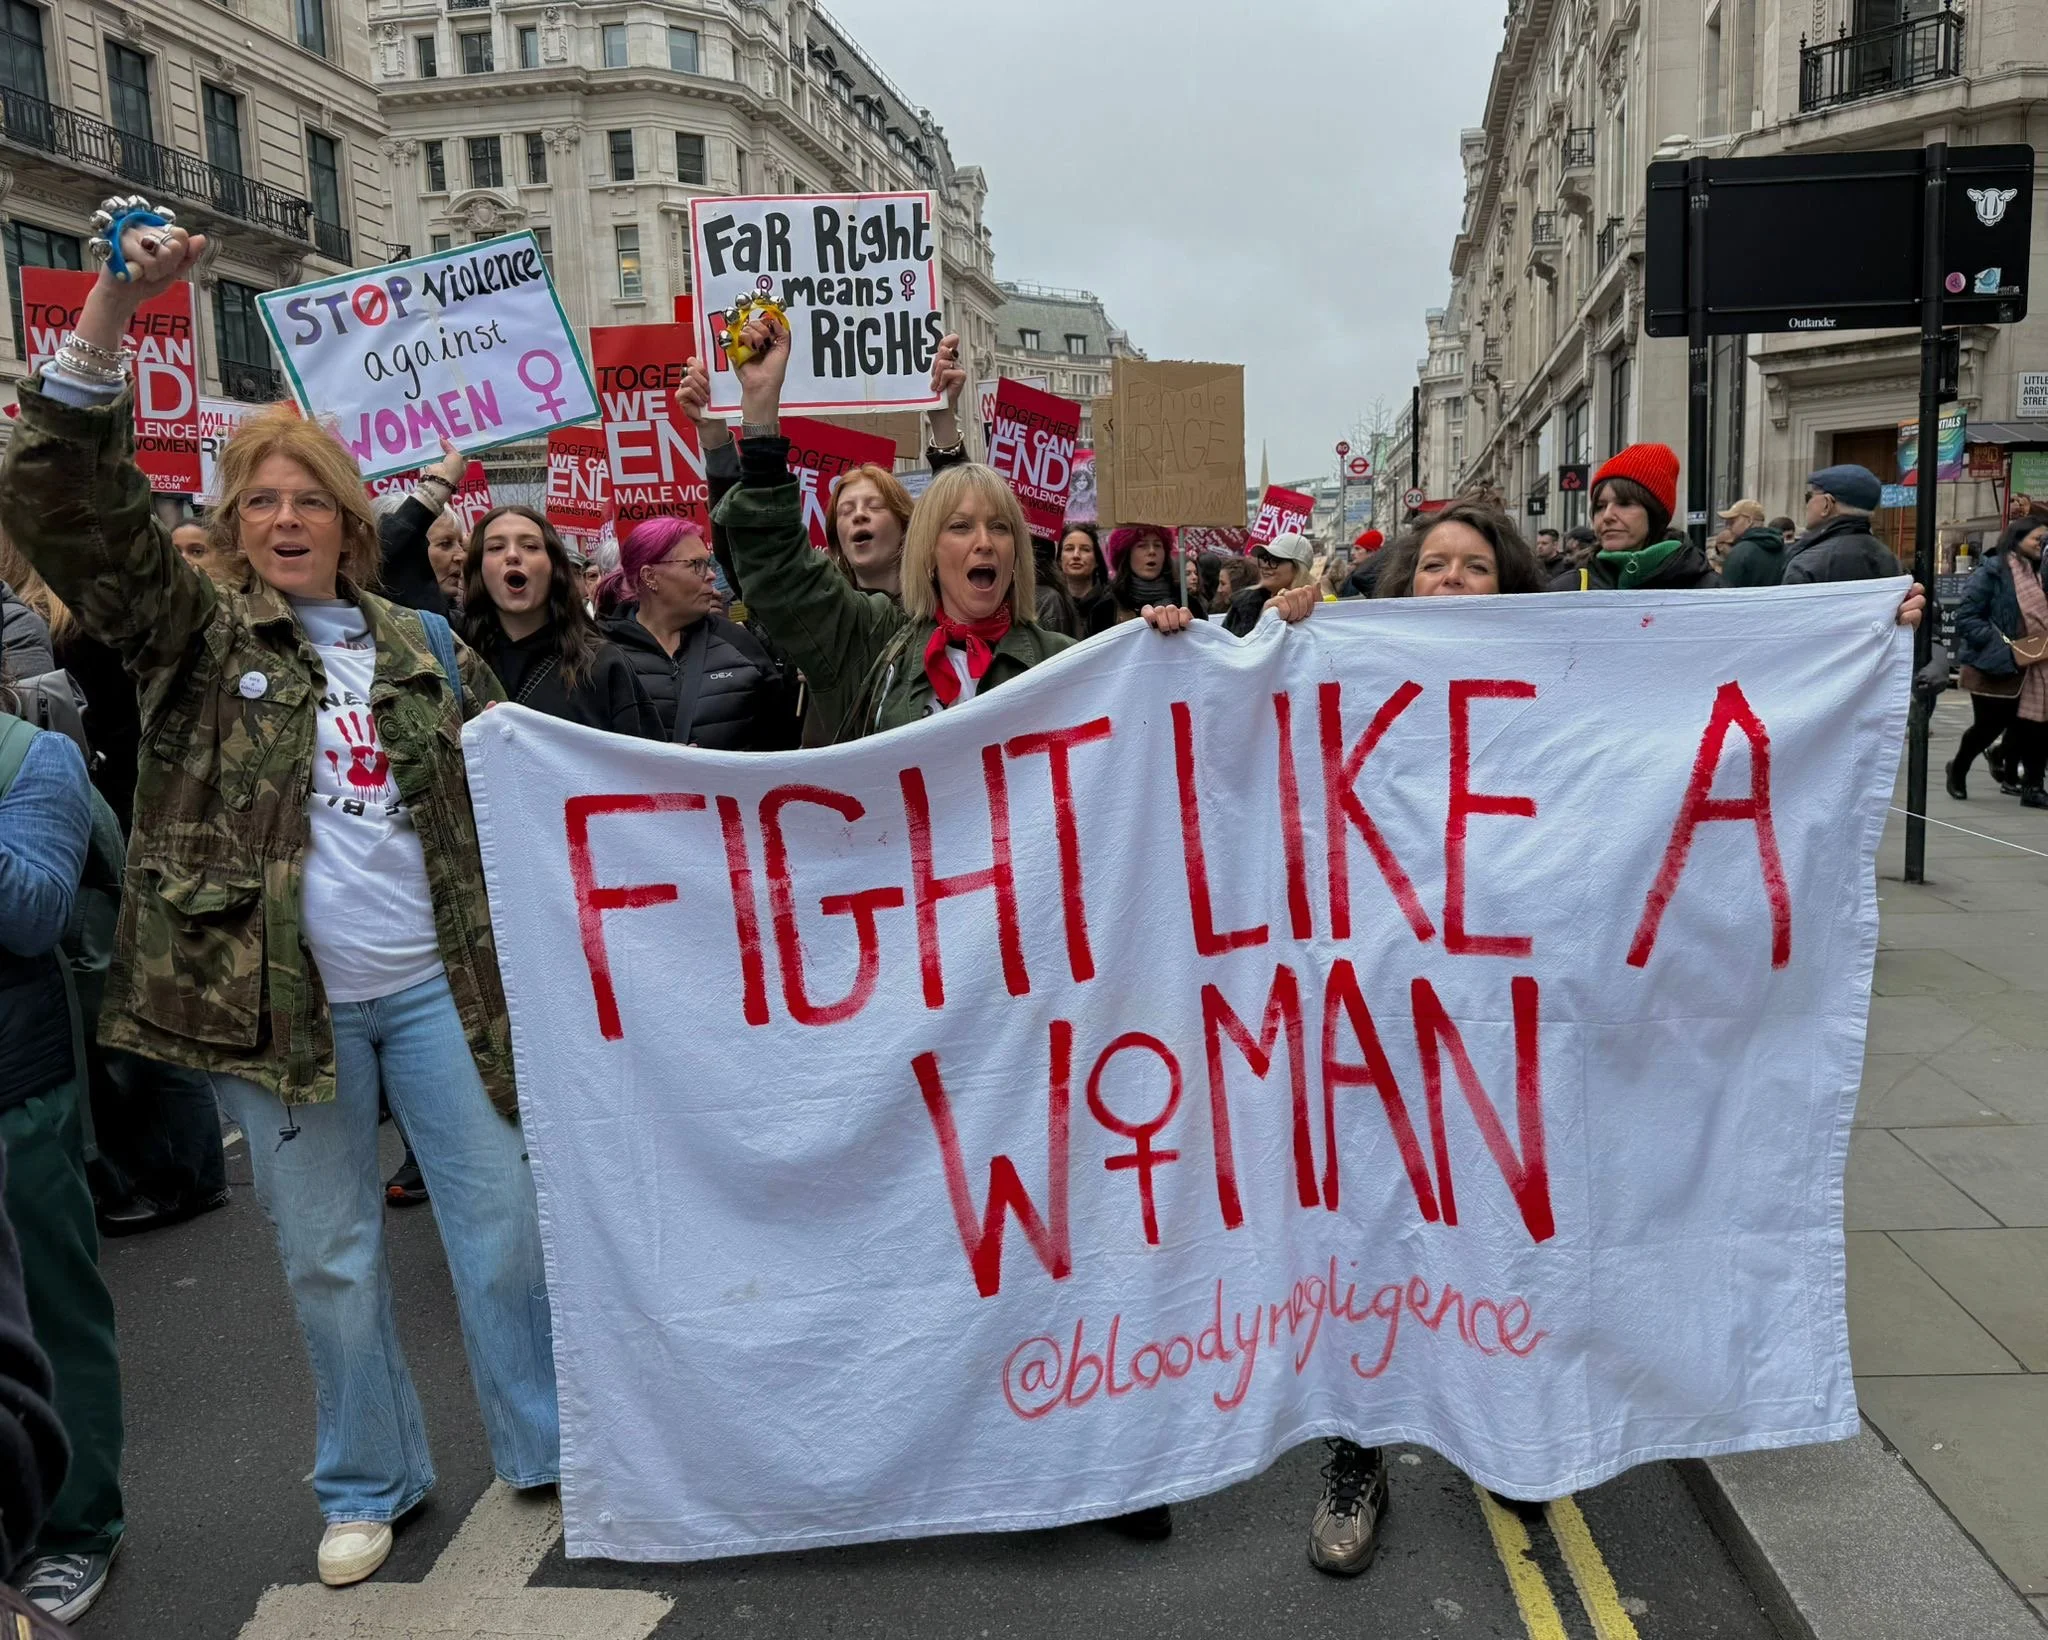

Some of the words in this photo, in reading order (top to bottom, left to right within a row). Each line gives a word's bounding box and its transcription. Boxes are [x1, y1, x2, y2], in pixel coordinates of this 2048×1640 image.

[813, 203, 934, 274] Right
[782, 276, 893, 307] means
[286, 276, 412, 345] STOP
[30, 327, 70, 355] W
[364, 320, 507, 400] against
[597, 363, 688, 391] TOGE
[2023, 397, 2048, 405] STREE
[2024, 387, 2048, 395] ARGYL
[602, 389, 669, 421] WE
[134, 421, 198, 439] LENCE
[326, 380, 503, 462] WOMEN
[997, 402, 1078, 440] TOGETHER
[996, 416, 1028, 443] WE
[1033, 430, 1075, 458] CAN
[549, 441, 606, 459] TOGETH
[604, 420, 708, 485] EN
[1135, 418, 1226, 481] RAGE
[550, 453, 579, 470] WE
[585, 458, 609, 473] CA
[988, 434, 1070, 492] END
[172, 475, 191, 483] DAY
[372, 478, 419, 494] CAN
[452, 490, 490, 507] CAN
[547, 497, 575, 508] MALE
[577, 501, 604, 511] VIOLE
[614, 486, 676, 505] MALE
[1017, 483, 1067, 507] VIOLENCE
[1407, 493, 1422, 503] 20
[547, 506, 585, 516] AGAINST
[618, 502, 698, 521] AGAINST
[1262, 503, 1281, 517] WE
[1282, 509, 1308, 526] CAN
[1253, 512, 1303, 536] END
[710, 671, 733, 680] OEX
[565, 717, 1111, 1041] FIGHT
[1171, 680, 1537, 956] LIKE
[1626, 680, 1791, 969] A
[1002, 1255, 1550, 1420] @bloodynegligence
